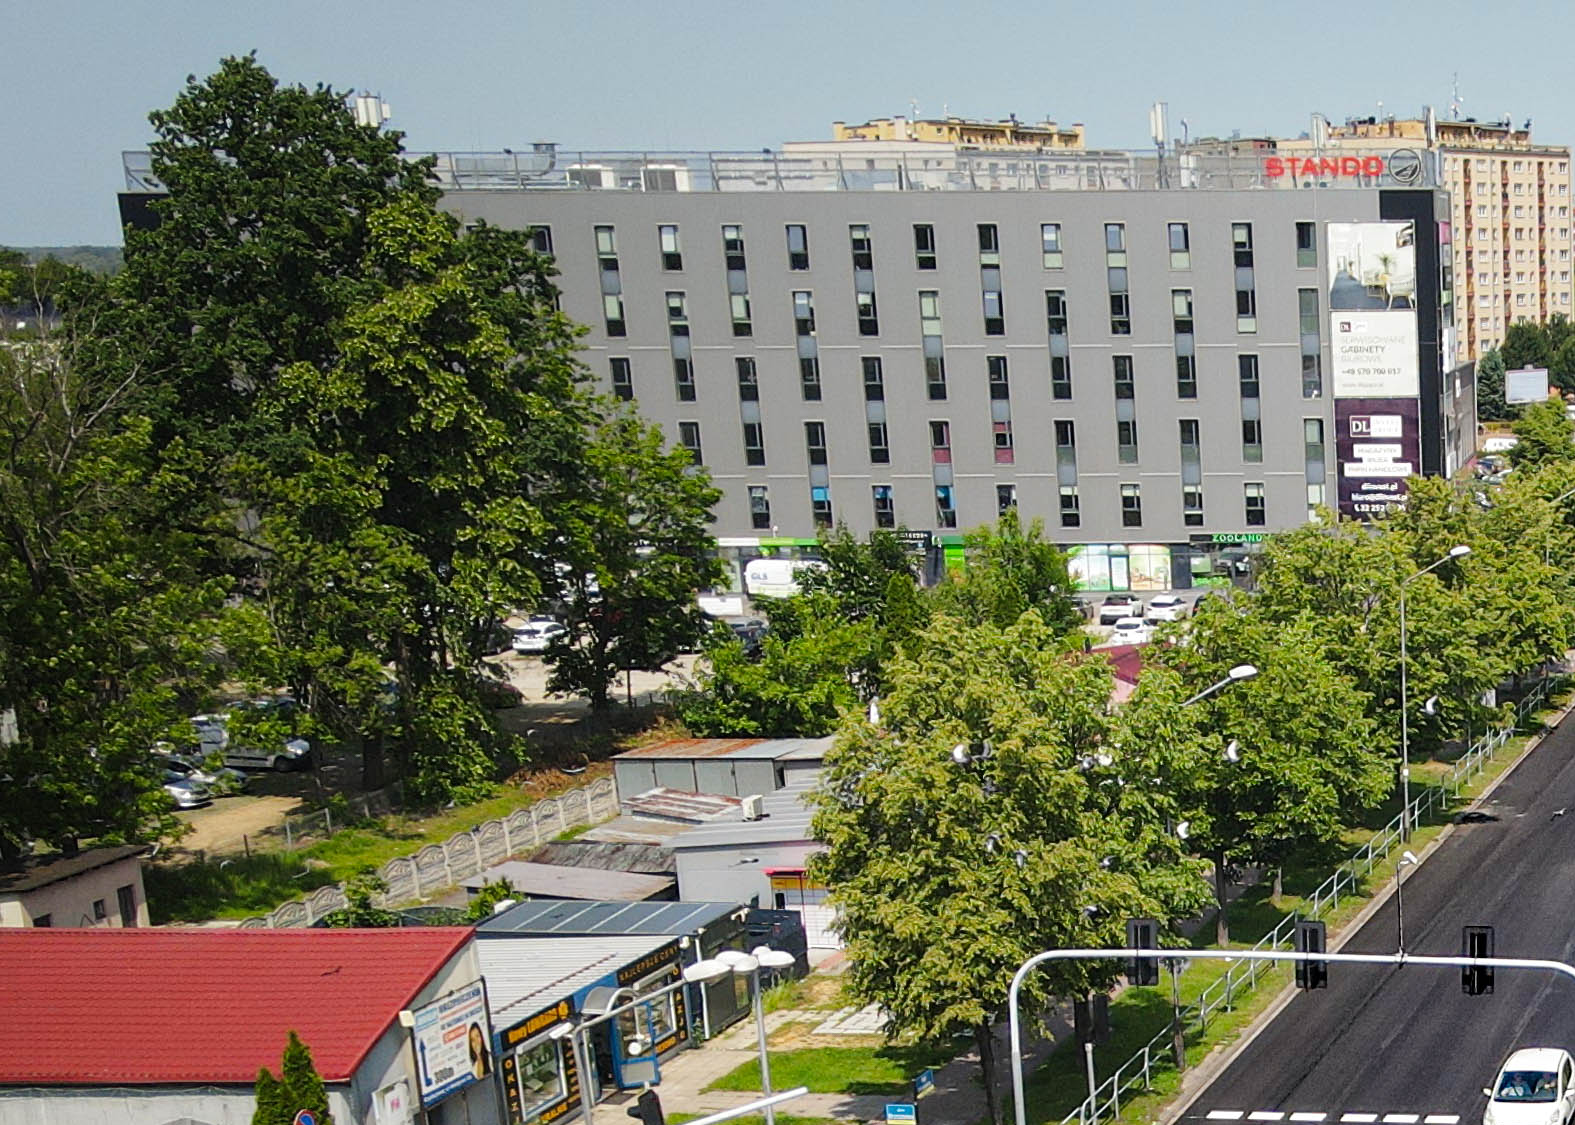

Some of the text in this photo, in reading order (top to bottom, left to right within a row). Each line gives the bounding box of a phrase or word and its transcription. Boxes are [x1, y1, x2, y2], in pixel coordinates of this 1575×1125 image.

[1266, 156, 1384, 177] STANDO
[1341, 345, 1385, 353] GABINETY
[1352, 420, 1370, 433] DL
[1212, 534, 1263, 542] ZOOLAND
